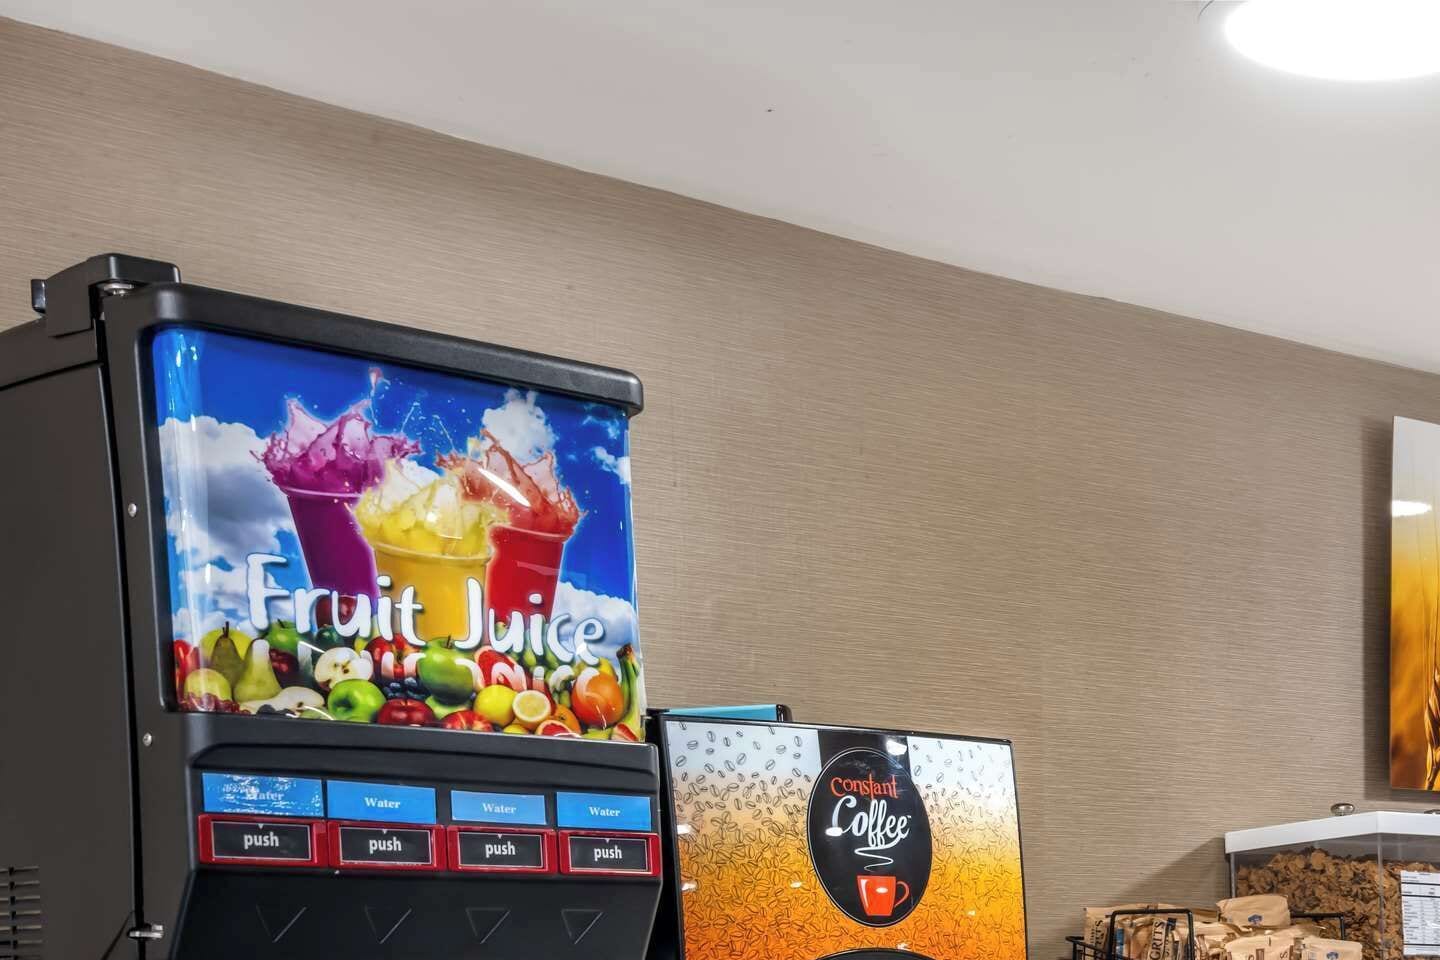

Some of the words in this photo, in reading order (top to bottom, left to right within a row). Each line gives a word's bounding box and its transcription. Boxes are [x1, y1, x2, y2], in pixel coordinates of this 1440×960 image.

[245, 553, 427, 646] Fruit
[454, 577, 604, 665] Juice
[364, 797, 401, 809] Water
[482, 803, 517, 814] Water
[589, 806, 621, 817] Water
[825, 795, 911, 849] Coffee
[243, 831, 280, 849] push
[369, 836, 402, 854] push
[485, 841, 516, 857] push
[594, 845, 622, 861] push
[1149, 921, 1166, 960] GRITS
